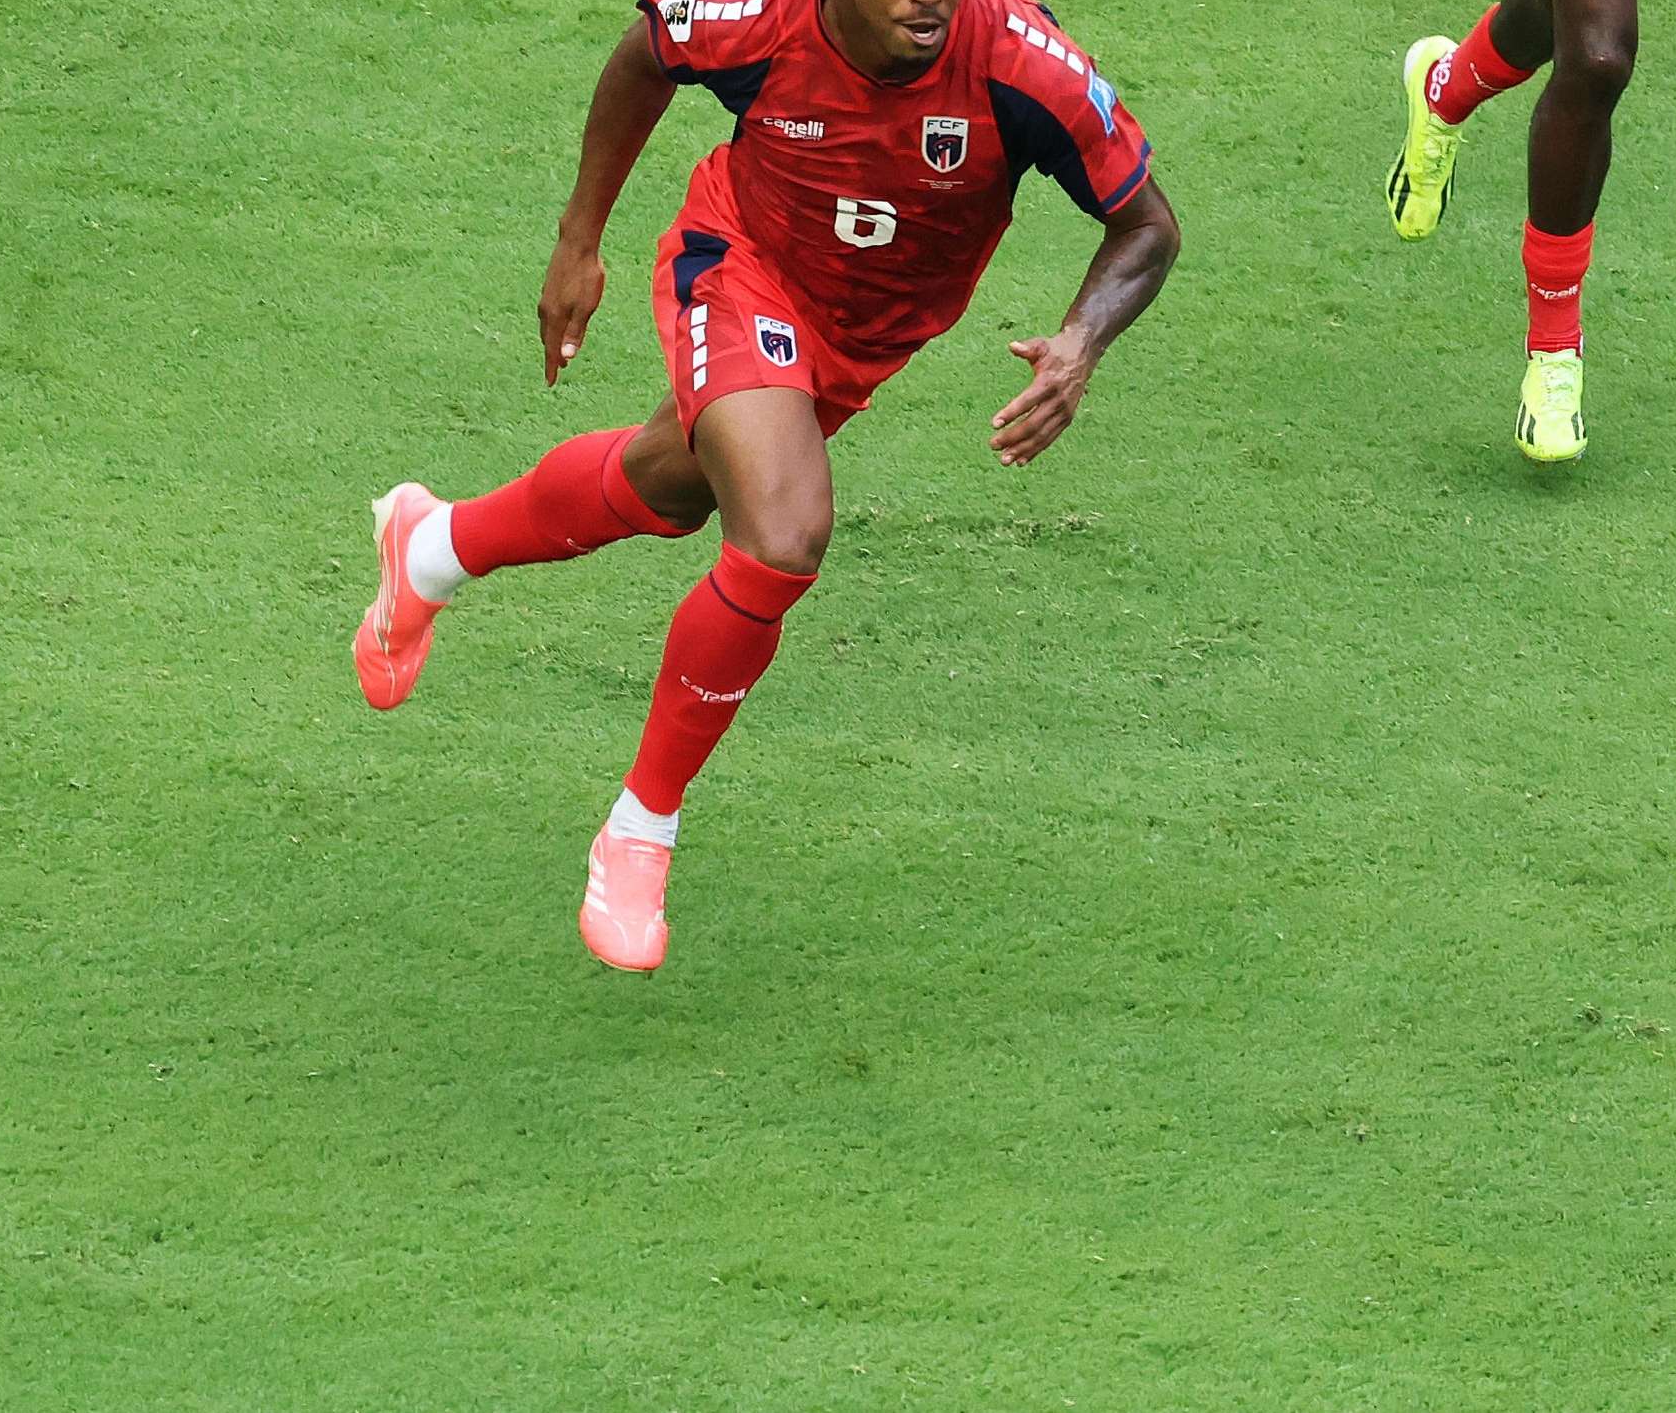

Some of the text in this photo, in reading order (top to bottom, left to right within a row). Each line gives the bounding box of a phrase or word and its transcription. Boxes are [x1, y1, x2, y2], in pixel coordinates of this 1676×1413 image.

[762, 117, 825, 138] capelli
[927, 119, 965, 129] FCF
[833, 195, 898, 248] 6
